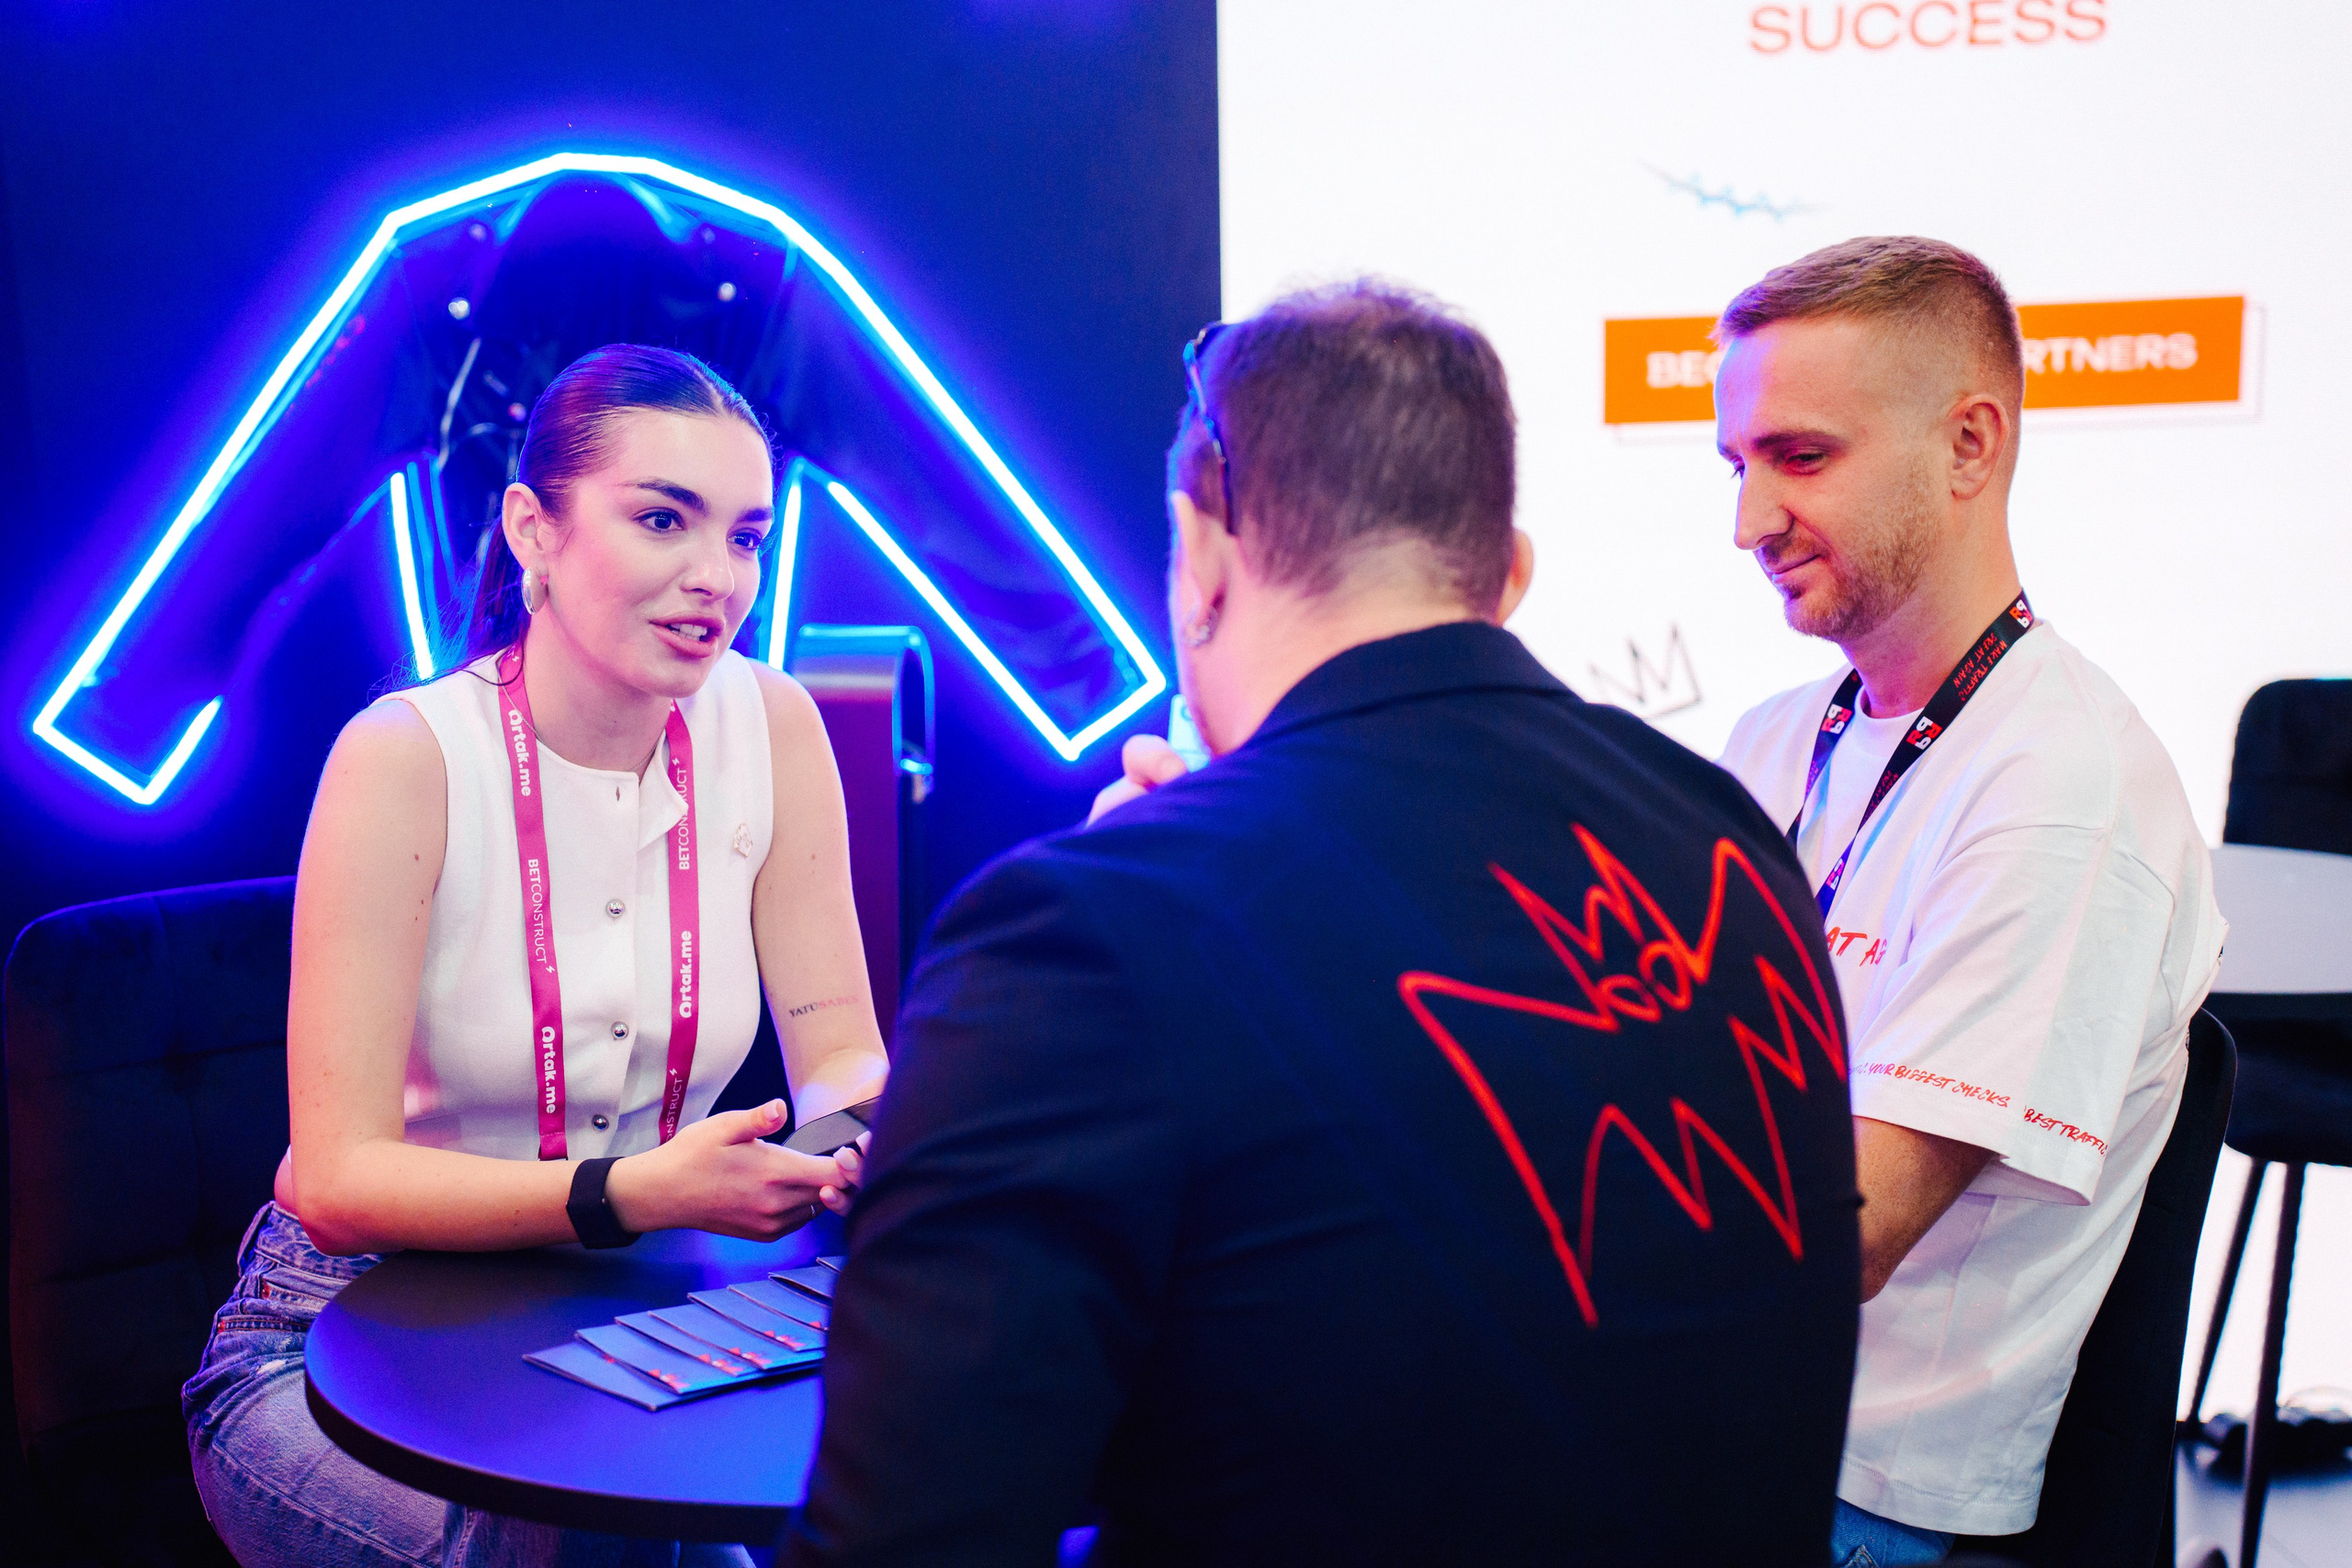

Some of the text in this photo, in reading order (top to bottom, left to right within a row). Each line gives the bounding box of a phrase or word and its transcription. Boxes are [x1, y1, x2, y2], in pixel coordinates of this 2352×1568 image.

[1749, 0, 2109, 55] SUCCESS
[2022, 332, 2199, 375] RTNERS
[1958, 639, 2008, 702] MAKE TRAFFIC
[677, 767, 691, 871] BETCONUCT
[527, 858, 548, 964] BETCONSTRUCT
[1826, 925, 1888, 968] AT AG
[1894, 1065, 1957, 1090] BIGGEST
[2023, 1108, 2064, 1133] BEST
